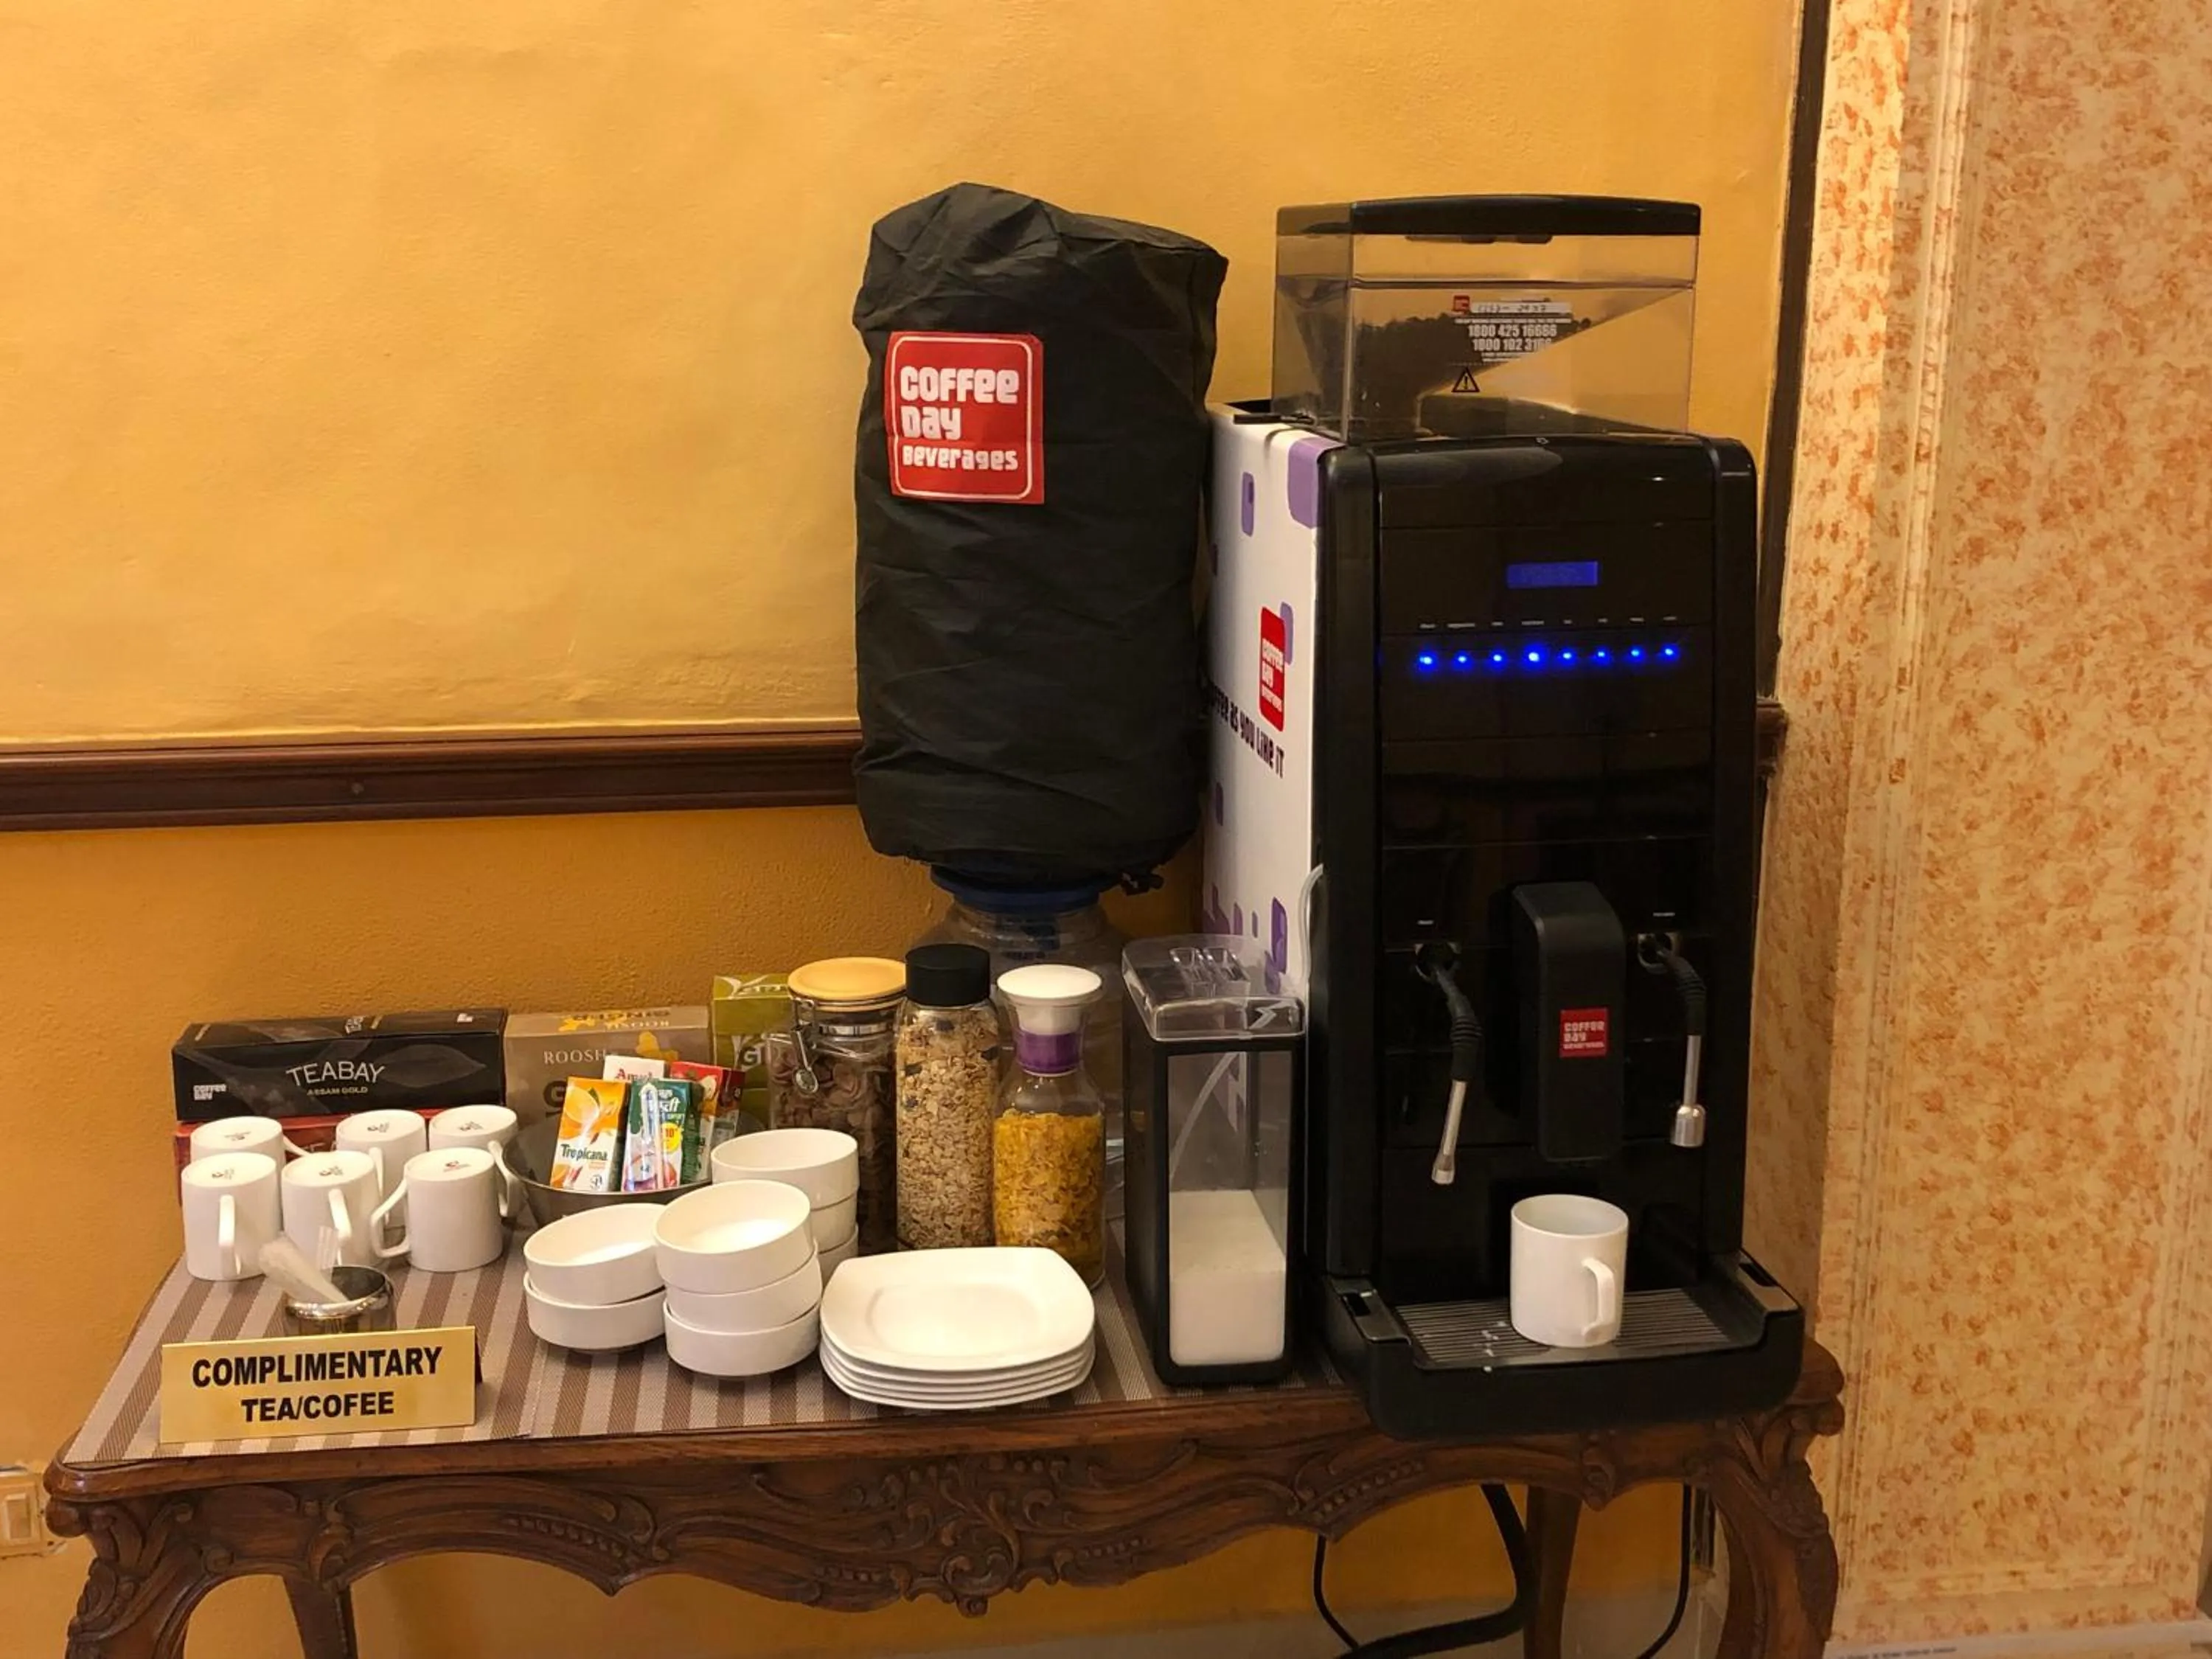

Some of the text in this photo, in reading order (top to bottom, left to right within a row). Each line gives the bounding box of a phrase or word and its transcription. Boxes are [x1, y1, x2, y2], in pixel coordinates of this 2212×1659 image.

[285, 1060, 386, 1086] TEABAY
[560, 1144, 608, 1161] Tropicana
[192, 1346, 442, 1388] COMPLIMENTARY
[241, 1391, 394, 1422] TEA/COFEE
